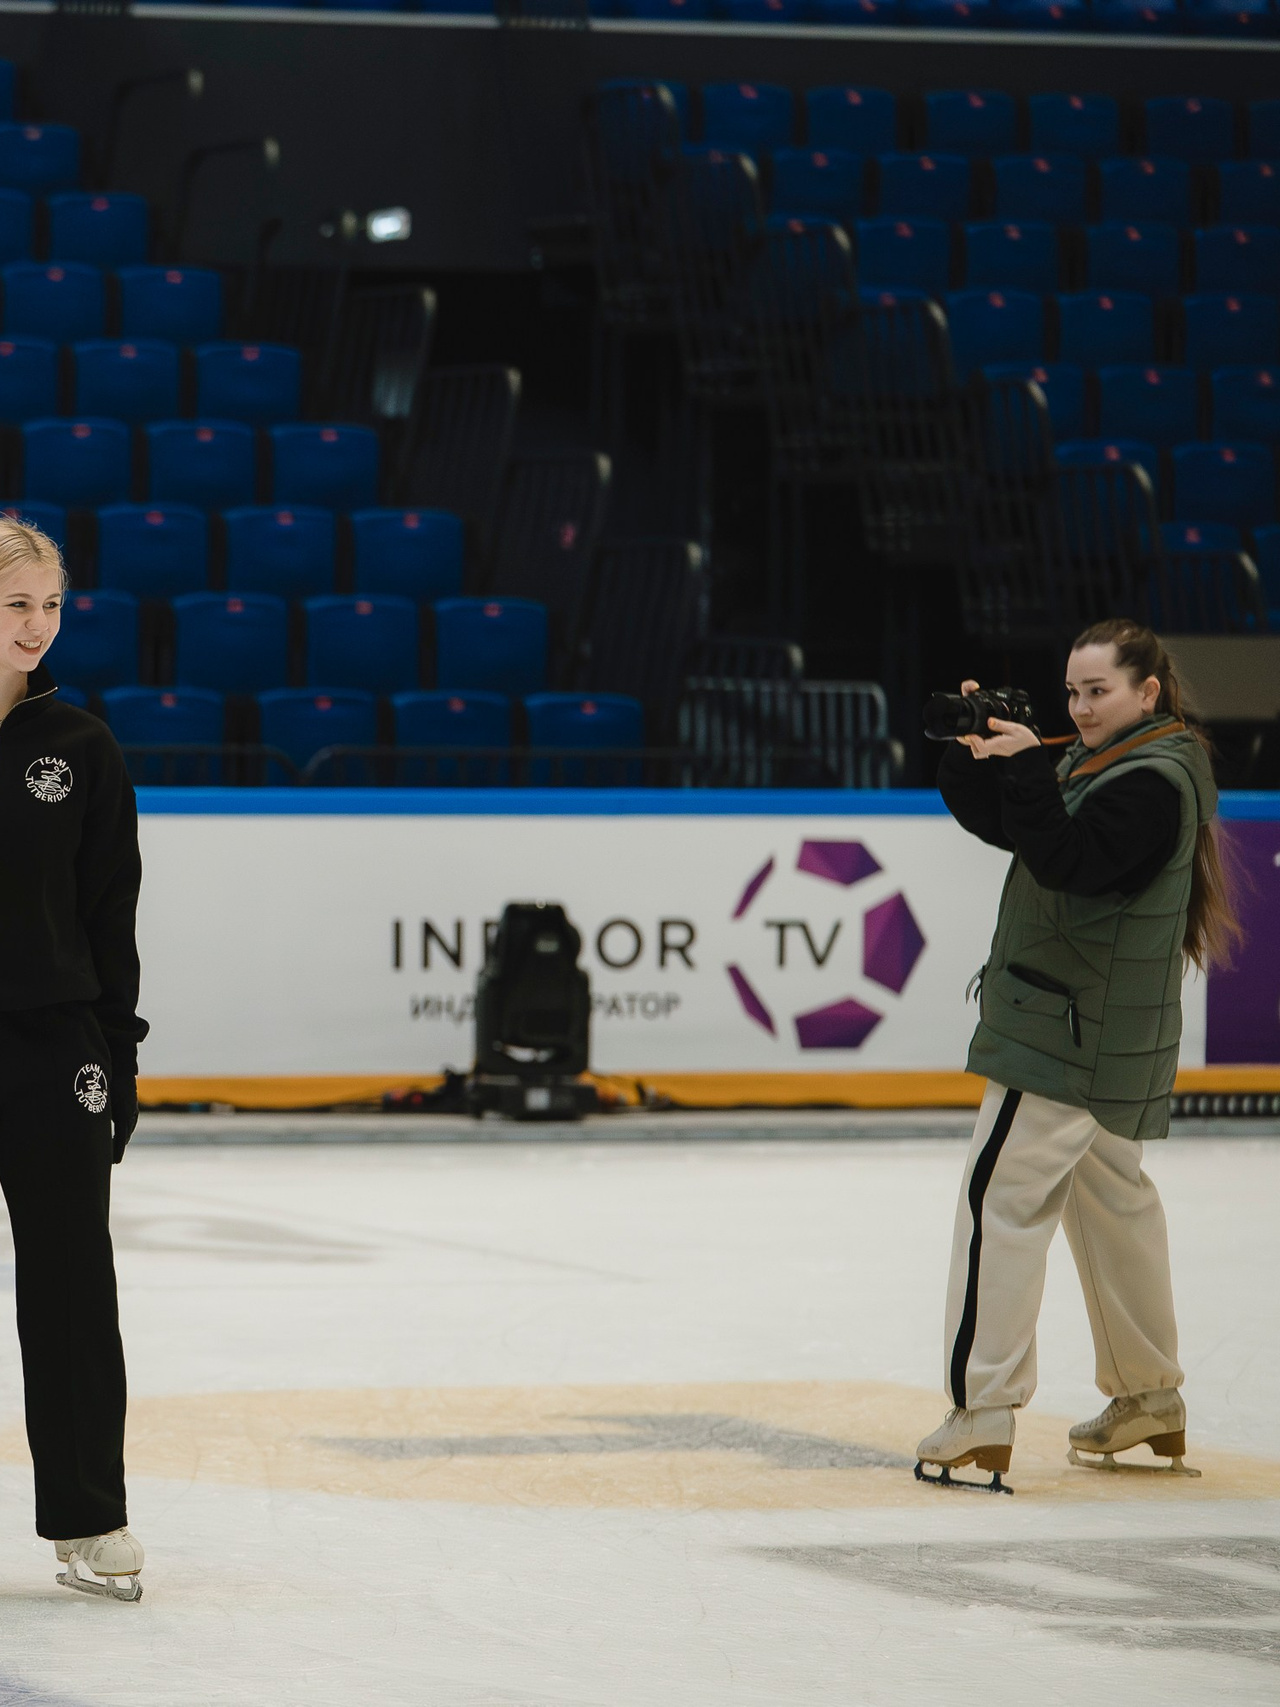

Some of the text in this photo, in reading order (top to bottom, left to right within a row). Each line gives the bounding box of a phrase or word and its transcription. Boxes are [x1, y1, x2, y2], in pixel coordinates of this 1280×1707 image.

[39, 757, 66, 768] TEAM
[25, 776, 71, 802] TUTBERIDZE
[764, 918, 842, 969] TV
[81, 1063, 100, 1075] TEAM
